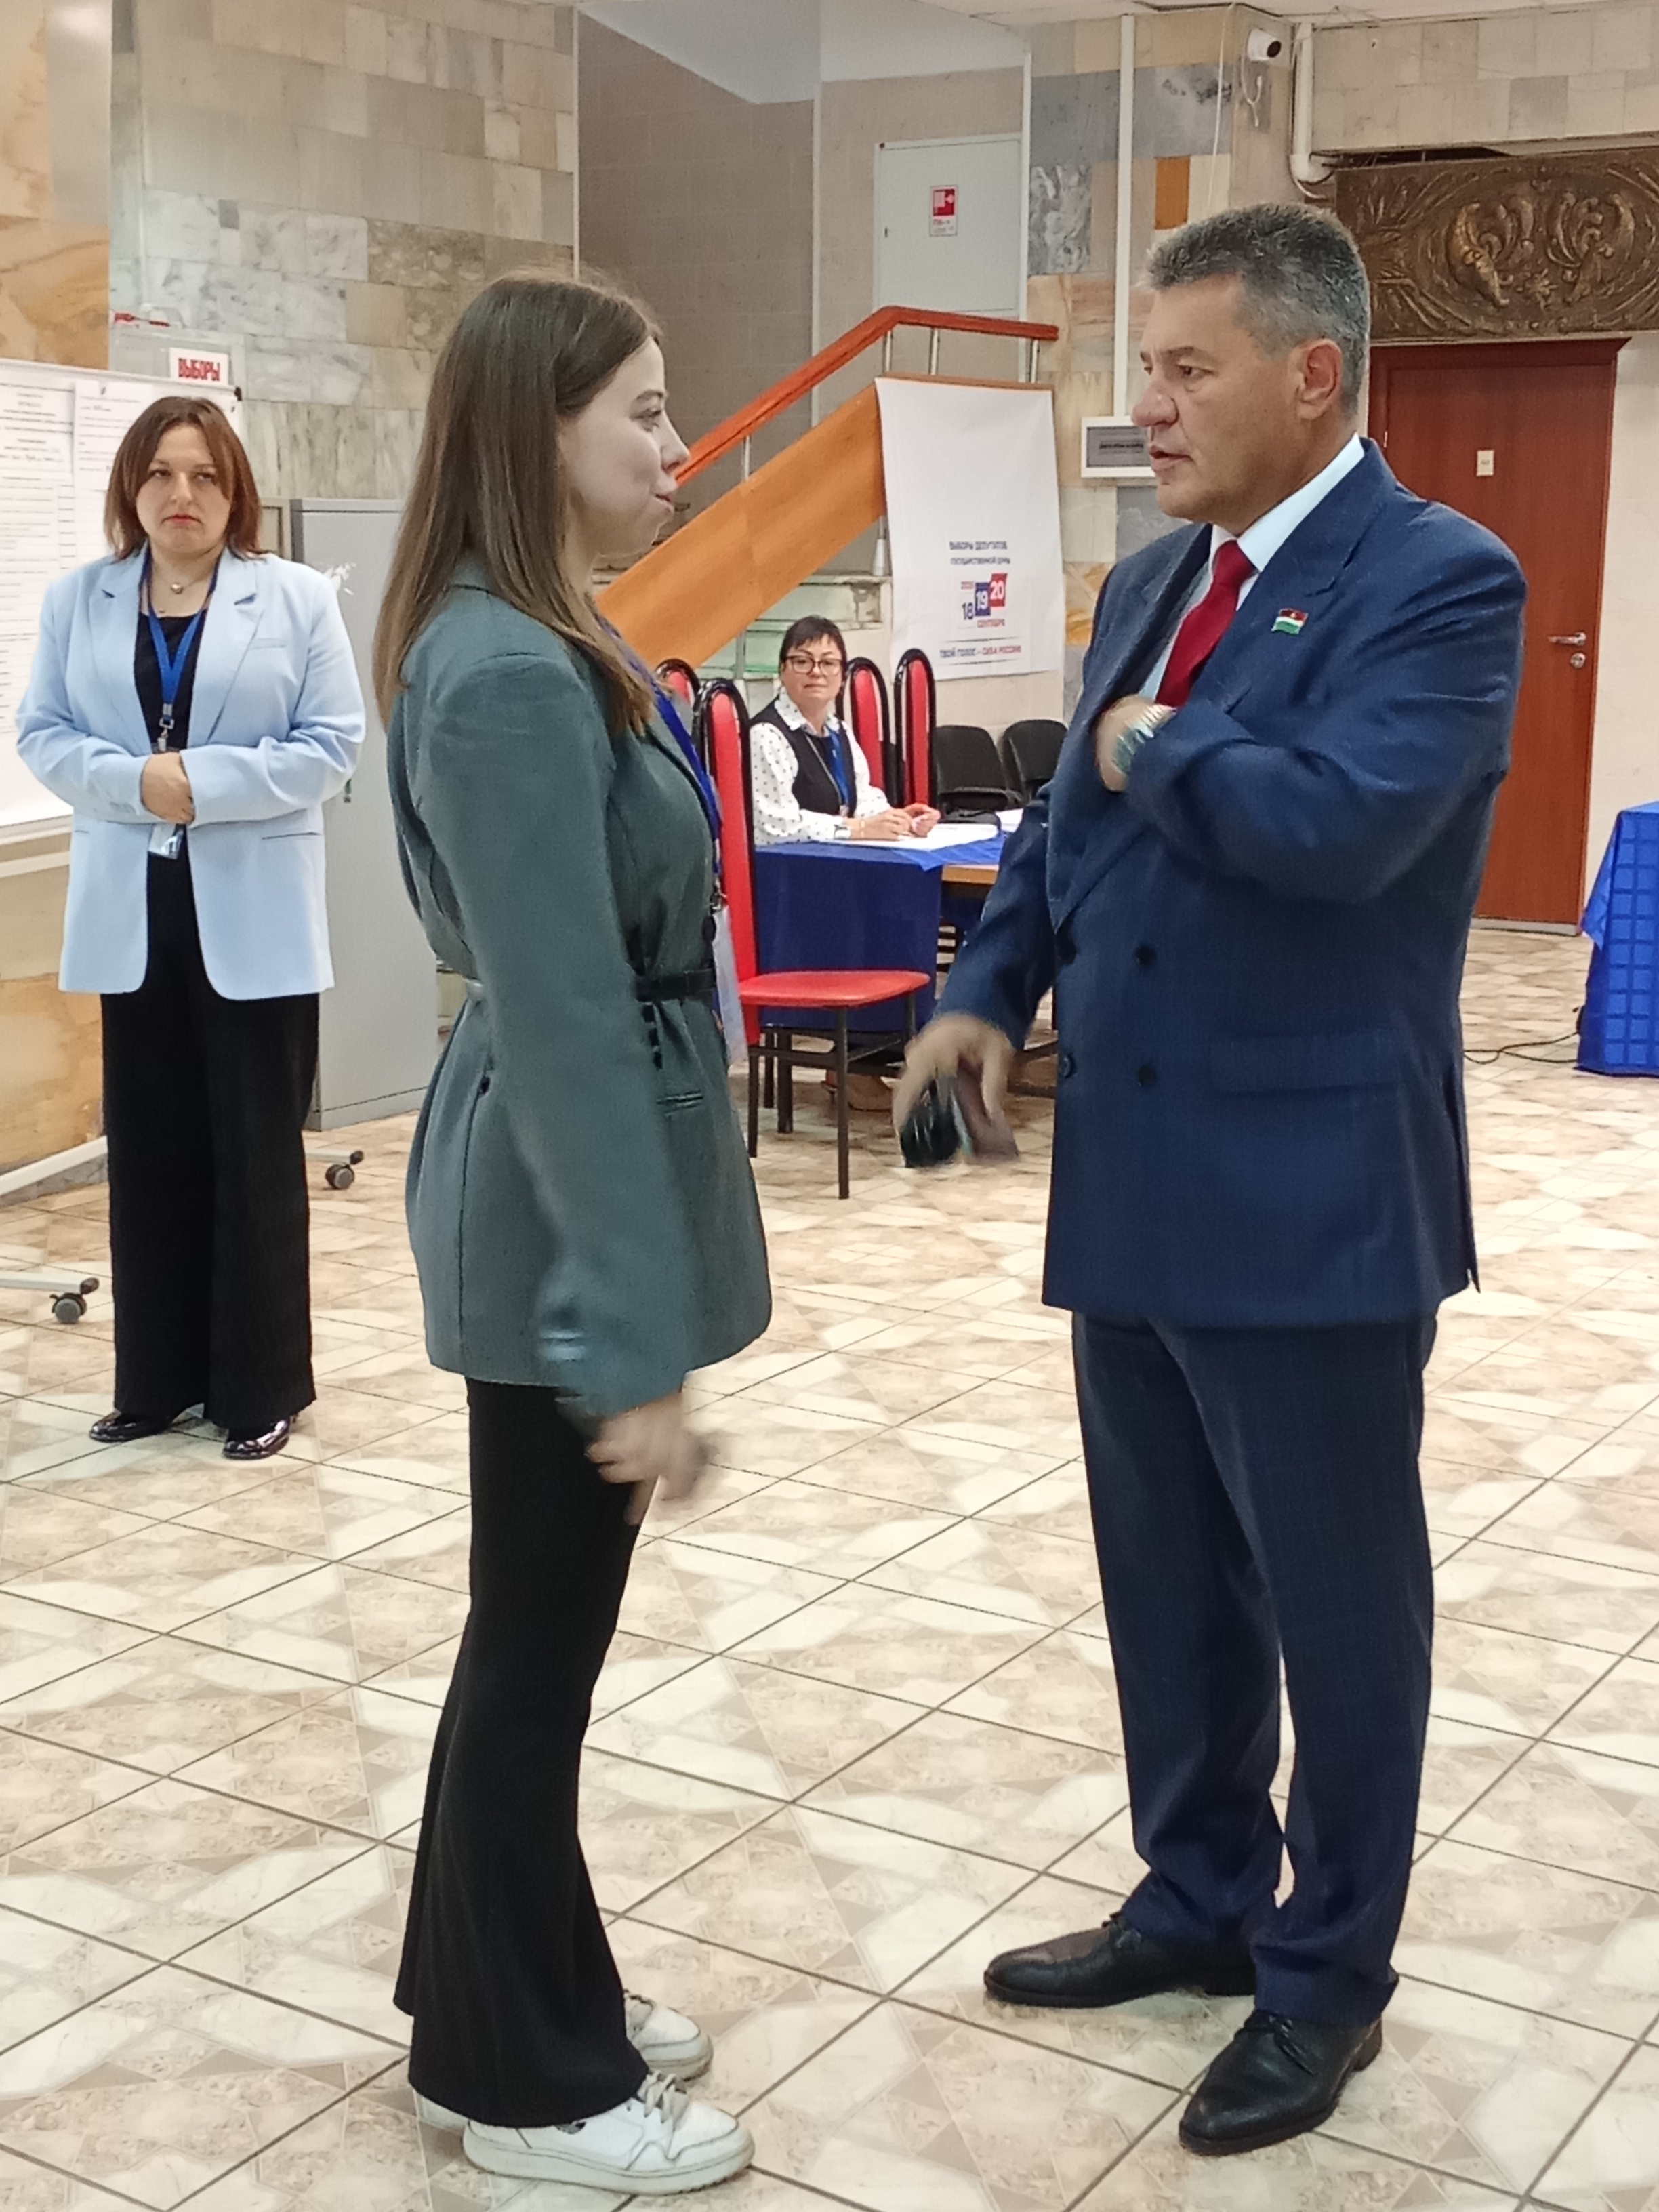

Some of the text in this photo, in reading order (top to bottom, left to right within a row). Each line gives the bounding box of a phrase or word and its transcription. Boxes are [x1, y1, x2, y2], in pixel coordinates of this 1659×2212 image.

[178, 357, 220, 382] ВЫБОРЫ
[962, 602, 974, 620] 18
[976, 590, 989, 611] 19
[990, 581, 1004, 600] 20
